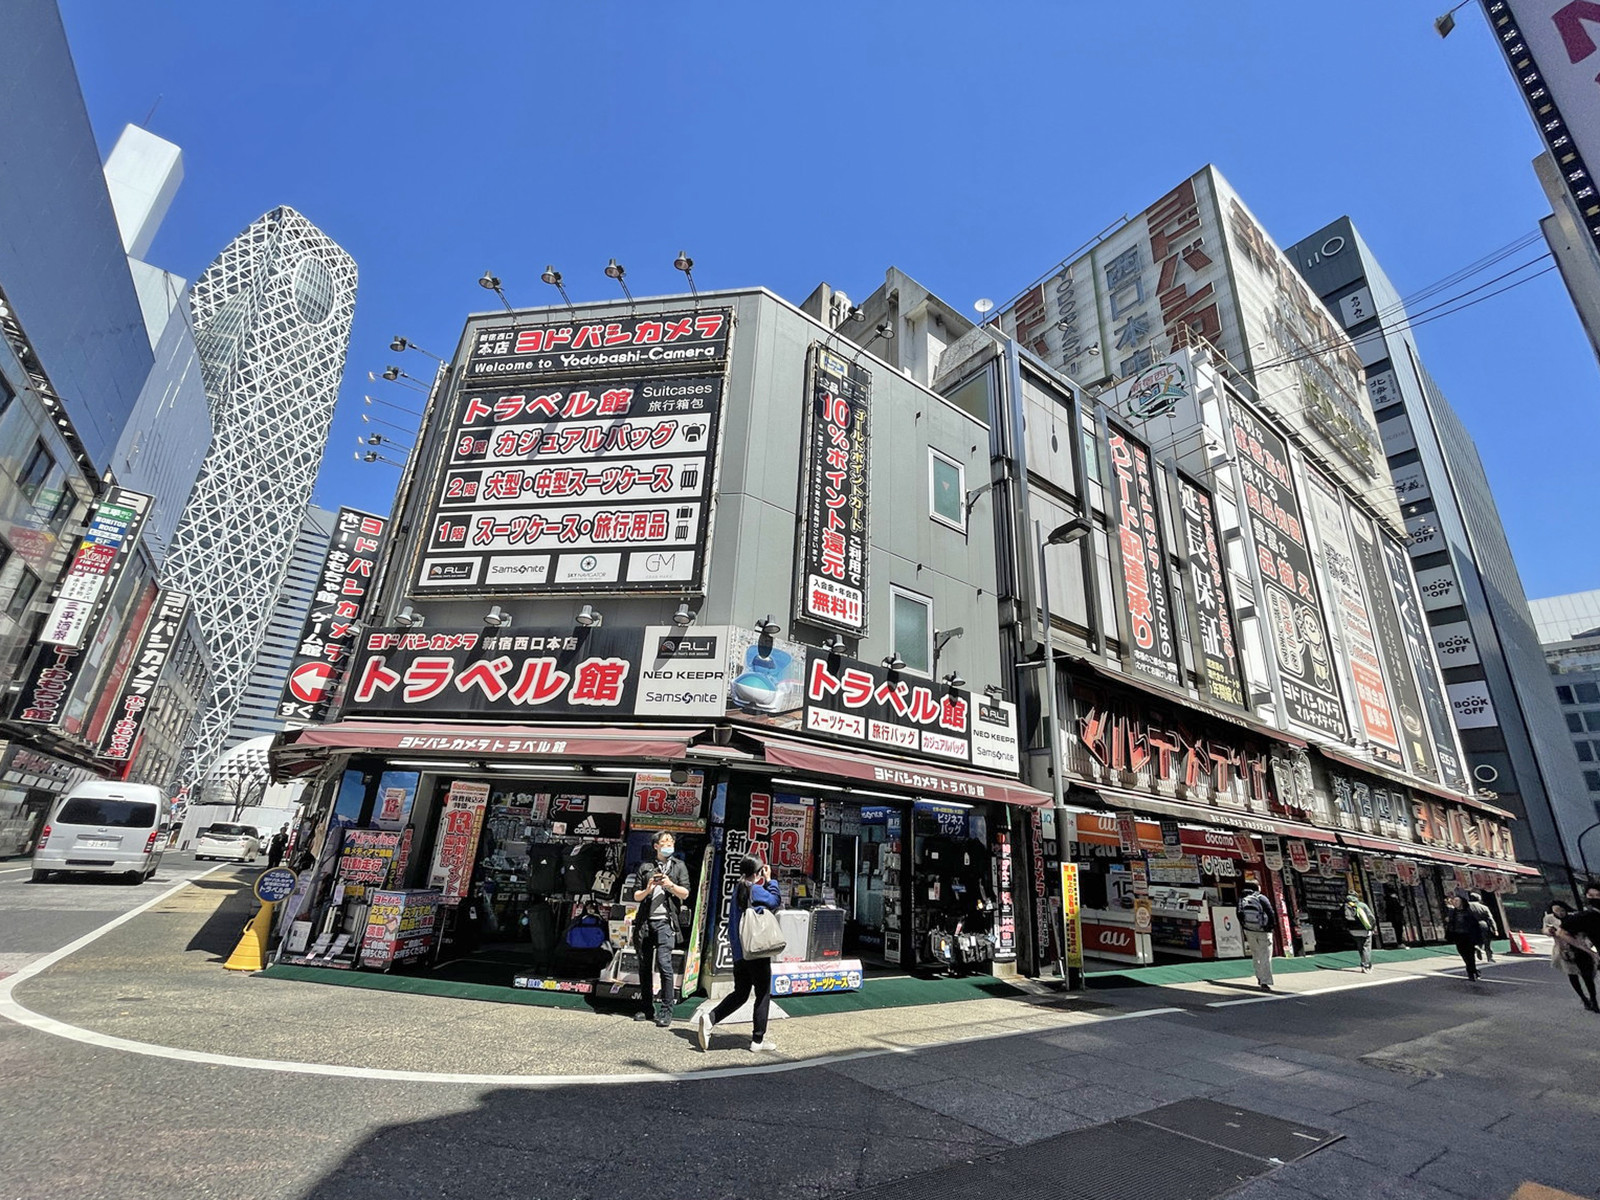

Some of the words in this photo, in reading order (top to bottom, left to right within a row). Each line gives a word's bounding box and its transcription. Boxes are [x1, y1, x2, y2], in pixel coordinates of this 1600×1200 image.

[515, 314, 724, 354] ヨドバシカメラ
[479, 342, 509, 354] 本店
[475, 360, 533, 373] Welcome
[538, 358, 552, 368] to
[560, 346, 714, 367] Yodobashi-Camera
[642, 384, 712, 398] Suitcases
[463, 388, 633, 424] トラベル館
[647, 398, 704, 412] 旅行箱包
[459, 437, 488, 454] 3階
[495, 421, 678, 457] カジュアルバッグ
[448, 479, 477, 497] 2階
[484, 464, 673, 500] 大型・中型スーツケース
[1244, 481, 1303, 545] 商品知識
[439, 522, 465, 541] 1階
[473, 513, 667, 544] スーツケース・旅行用品
[315, 512, 361, 606] ホビー・おもちゃ館
[1179, 478, 1224, 658] 延長保証
[492, 565, 544, 575] Samsonite
[1259, 545, 1315, 603] 品揃え
[324, 517, 383, 662] ヨドバシカメラ
[1422, 581, 1453, 593] BOOK
[1384, 544, 1425, 670] FIVE
[131, 591, 187, 695] ヨドバシカメラ
[300, 611, 332, 656] ゲーム館
[368, 633, 478, 651] ヨドバシカメラ
[482, 636, 577, 652] 新宿西口本店
[1438, 638, 1470, 649] BOOK
[355, 656, 630, 706] トラベル館
[643, 670, 673, 680] NEO
[677, 670, 724, 680] KEEPR
[645, 691, 718, 704] Samsonite
[809, 658, 967, 733] トラベル館
[1283, 681, 1340, 719] ヨドバシカメラ
[1454, 698, 1488, 709] BOOK
[281, 702, 314, 719] すぐ
[812, 711, 862, 735] スーツケース
[872, 724, 916, 745] 旅行バッグ
[973, 729, 992, 740] NEO
[993, 733, 1016, 744] KEEPR
[399, 737, 490, 752] ヨドバシカメラ
[491, 738, 567, 753] トラベル館
[923, 736, 965, 755] カジュアルバッグ
[977, 746, 1014, 762] Samsonite
[874, 767, 938, 790] ヨドバシカメラ
[940, 779, 985, 797] トラベル館
[636, 788, 673, 814] 13%
[937, 813, 964, 825] ビジネス
[574, 827, 600, 835] adidas
[941, 824, 961, 835] バッグ
[1205, 832, 1234, 846] docomo
[1213, 856, 1236, 877] Pixel
[260, 886, 291, 894] トラベル館
[1100, 930, 1131, 946] au
[810, 977, 848, 990] スーツケース
